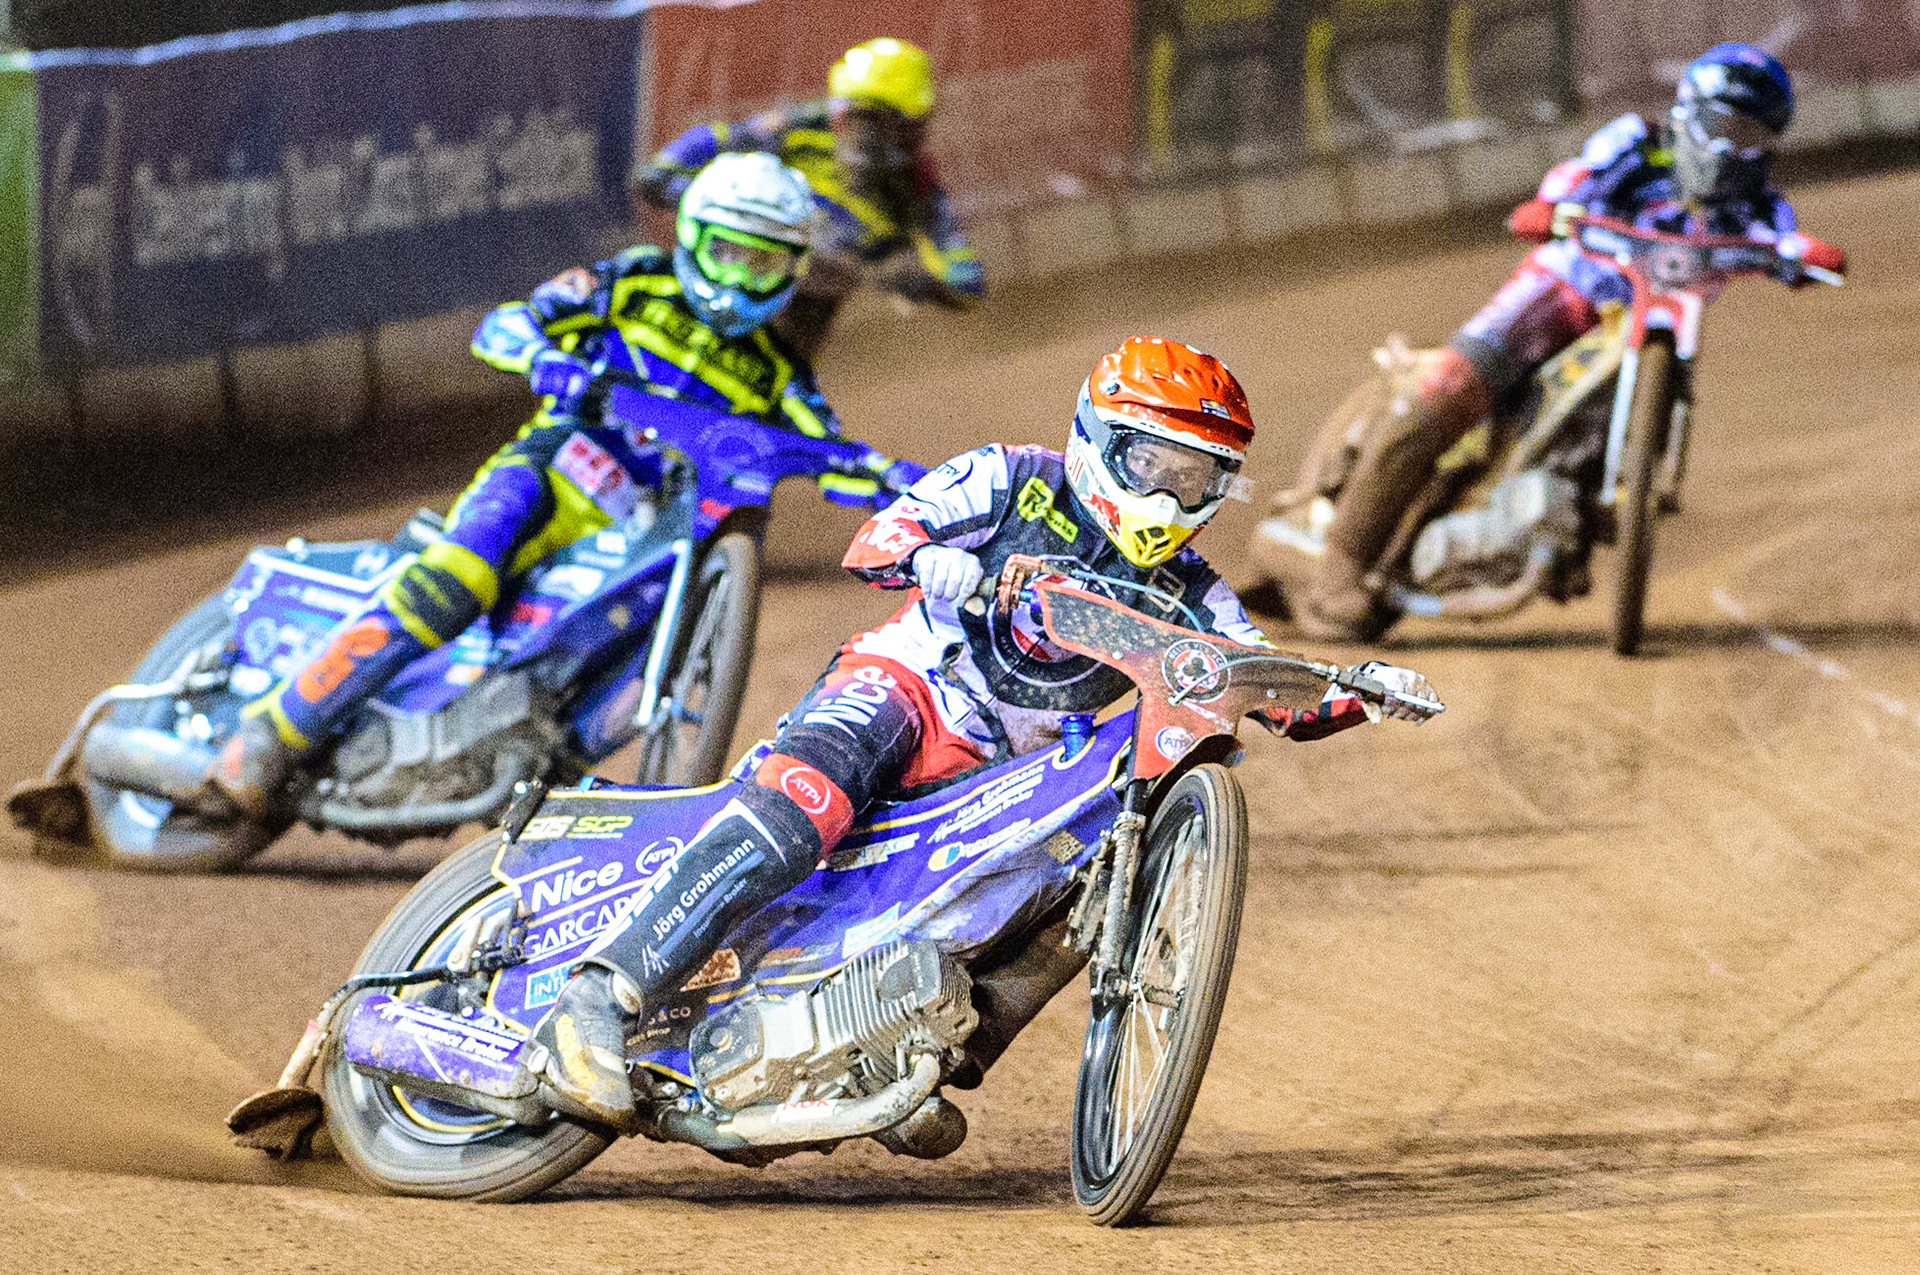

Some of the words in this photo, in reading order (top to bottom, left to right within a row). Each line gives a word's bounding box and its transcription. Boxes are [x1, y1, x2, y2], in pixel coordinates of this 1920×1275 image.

[788, 777, 823, 806] ATPI
[572, 814, 634, 833] SGP
[531, 861, 624, 913] Nice
[652, 904, 686, 941] Jörg
[680, 838, 756, 908] Grohmann
